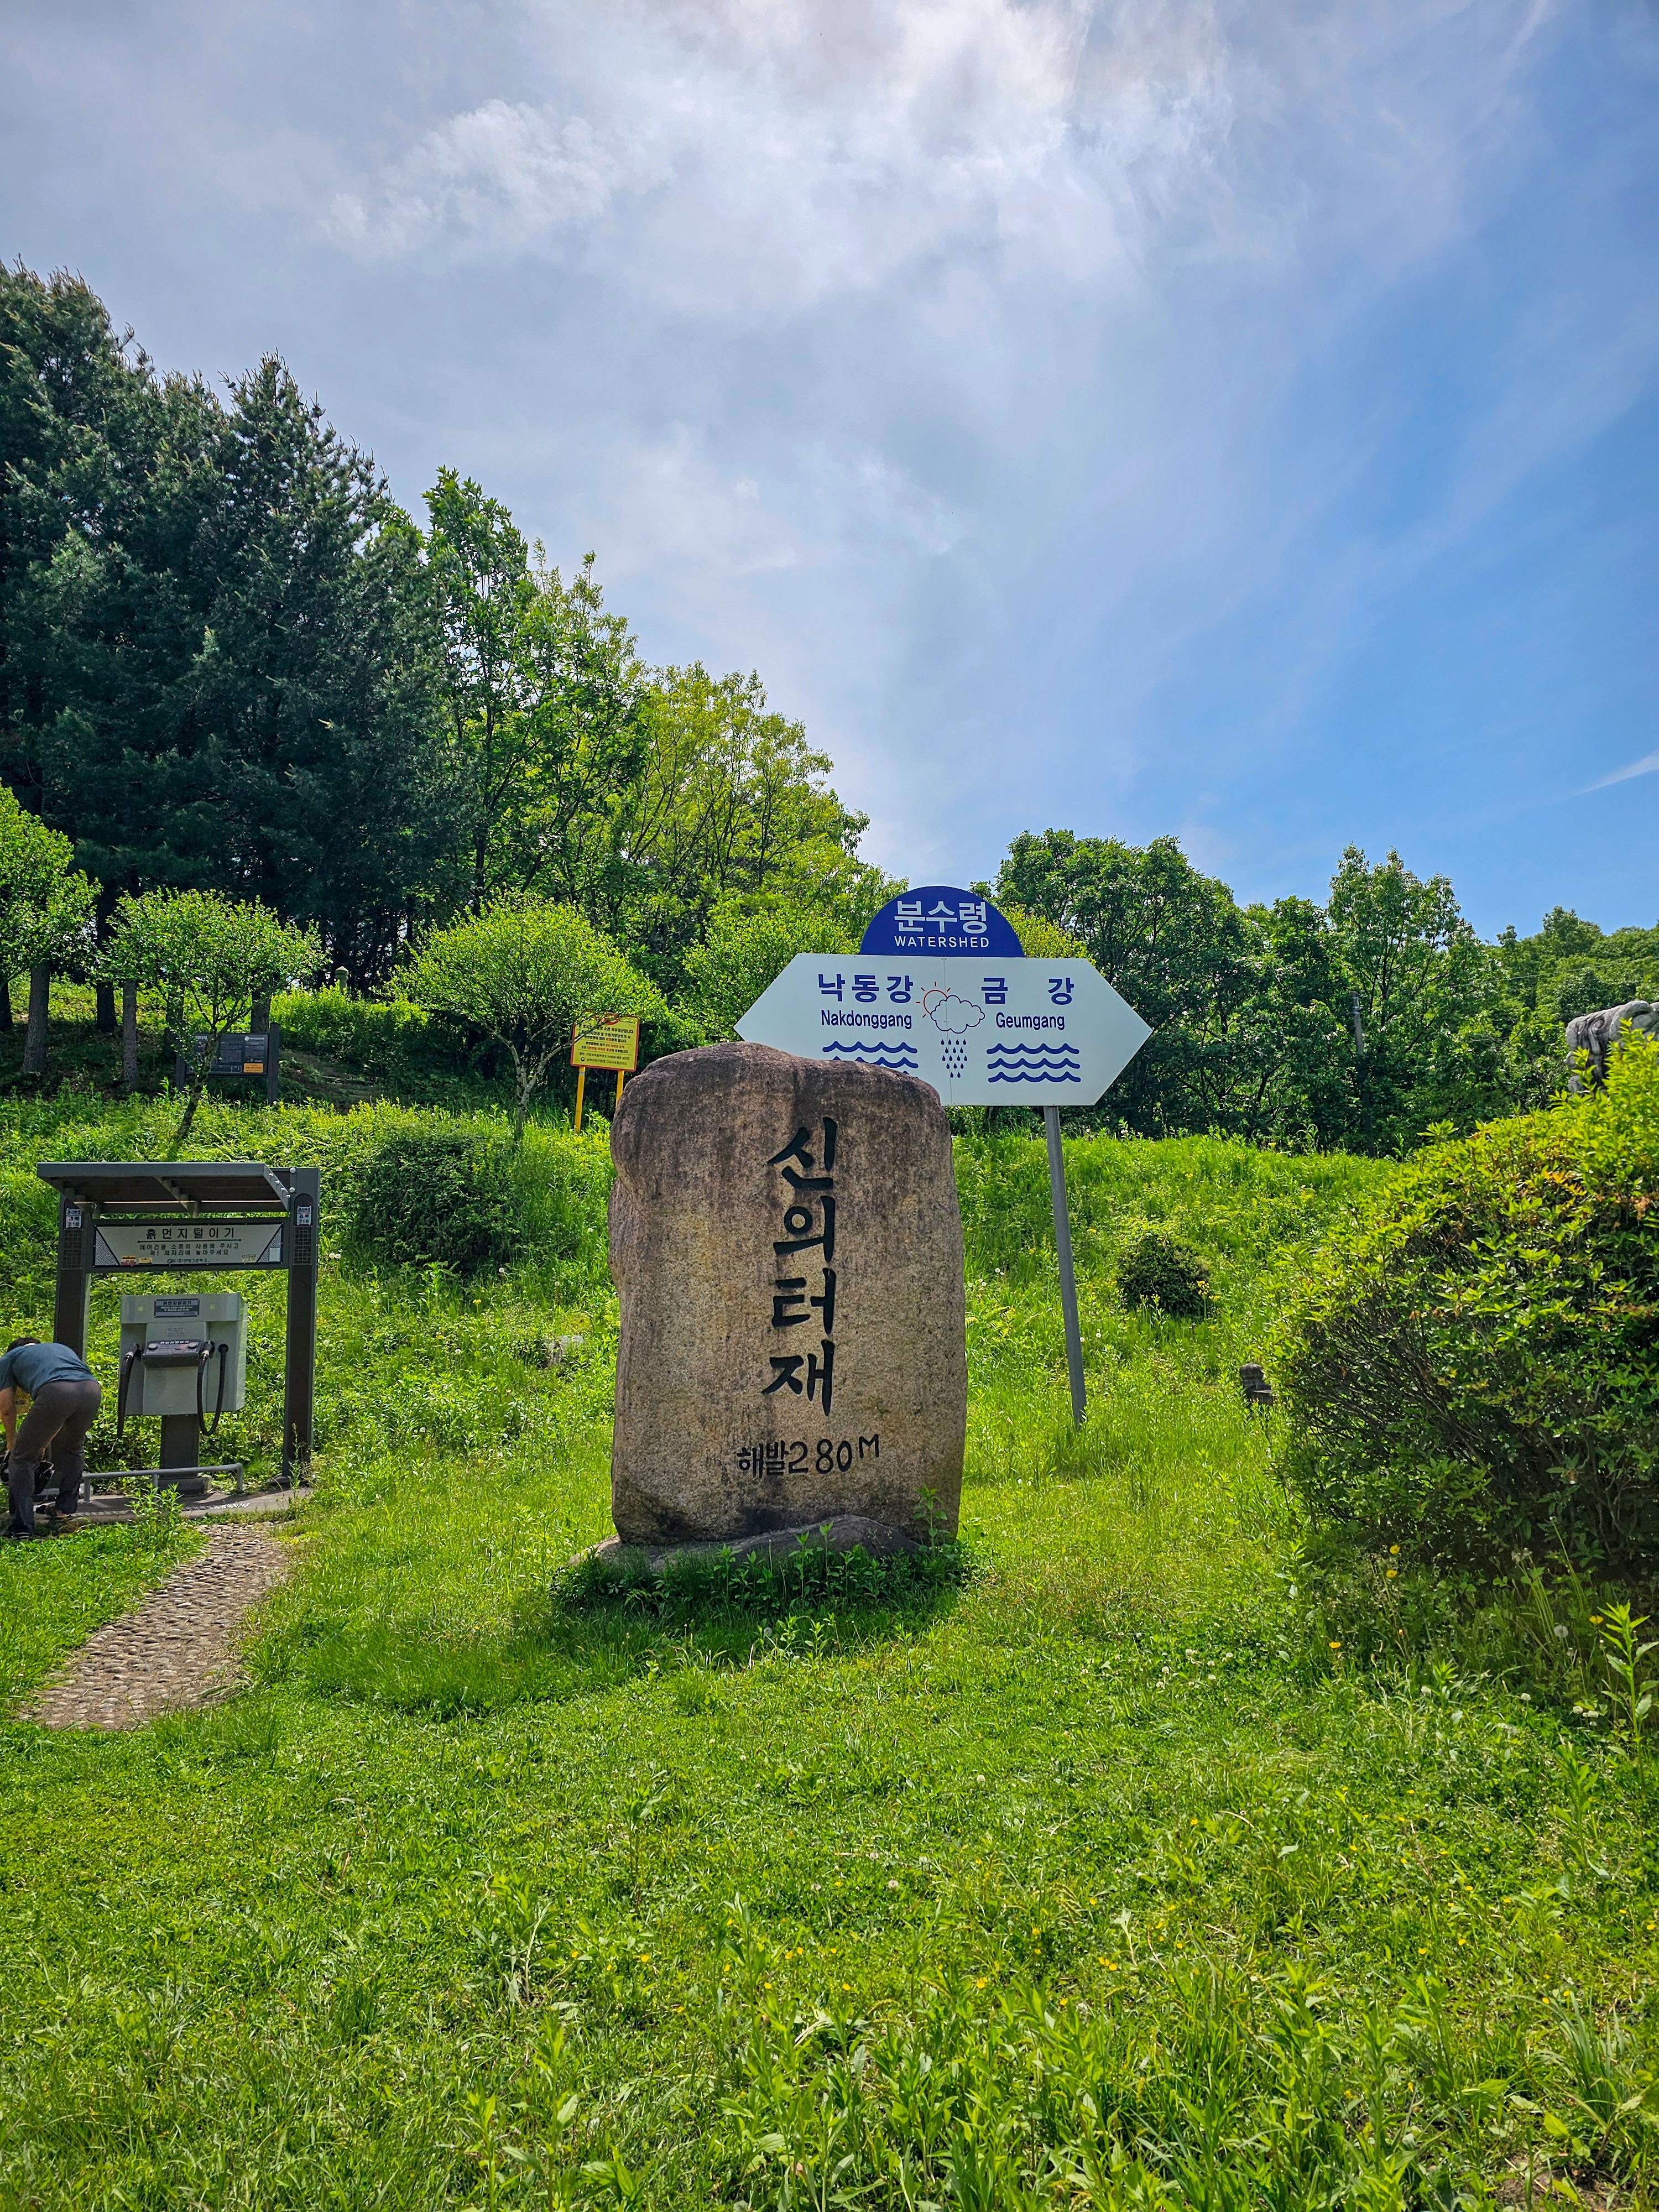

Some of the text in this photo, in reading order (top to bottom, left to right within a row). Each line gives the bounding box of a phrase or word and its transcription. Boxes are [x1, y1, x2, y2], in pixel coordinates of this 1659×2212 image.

[894, 900, 988, 934] 분수령
[895, 936, 989, 948] WATERSHED
[818, 974, 913, 1003] 낙동강
[821, 1010, 912, 1029] Nakdonggang
[995, 1011, 1065, 1030] Geumgang
[761, 1117, 838, 1416] 신의터재
